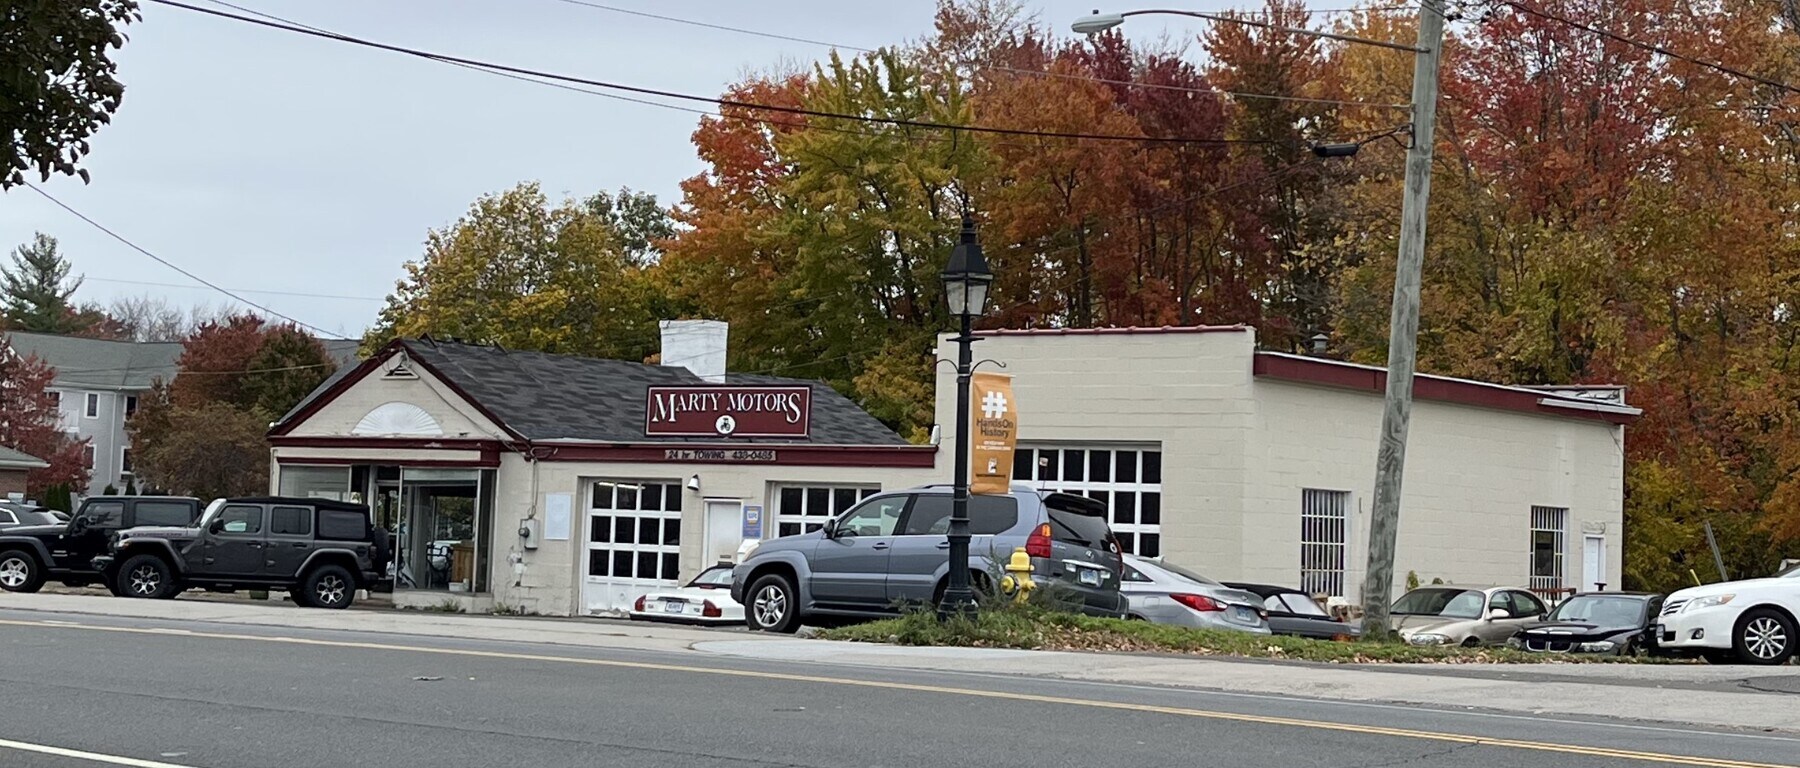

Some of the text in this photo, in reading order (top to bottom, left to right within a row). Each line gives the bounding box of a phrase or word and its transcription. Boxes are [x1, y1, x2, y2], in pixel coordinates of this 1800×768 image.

[651, 392, 801, 424] MARTY MOTORS
[980, 427, 1010, 439] History
[668, 450, 678, 460] 24
[682, 450, 690, 460] hr
[694, 450, 725, 460] TOWING
